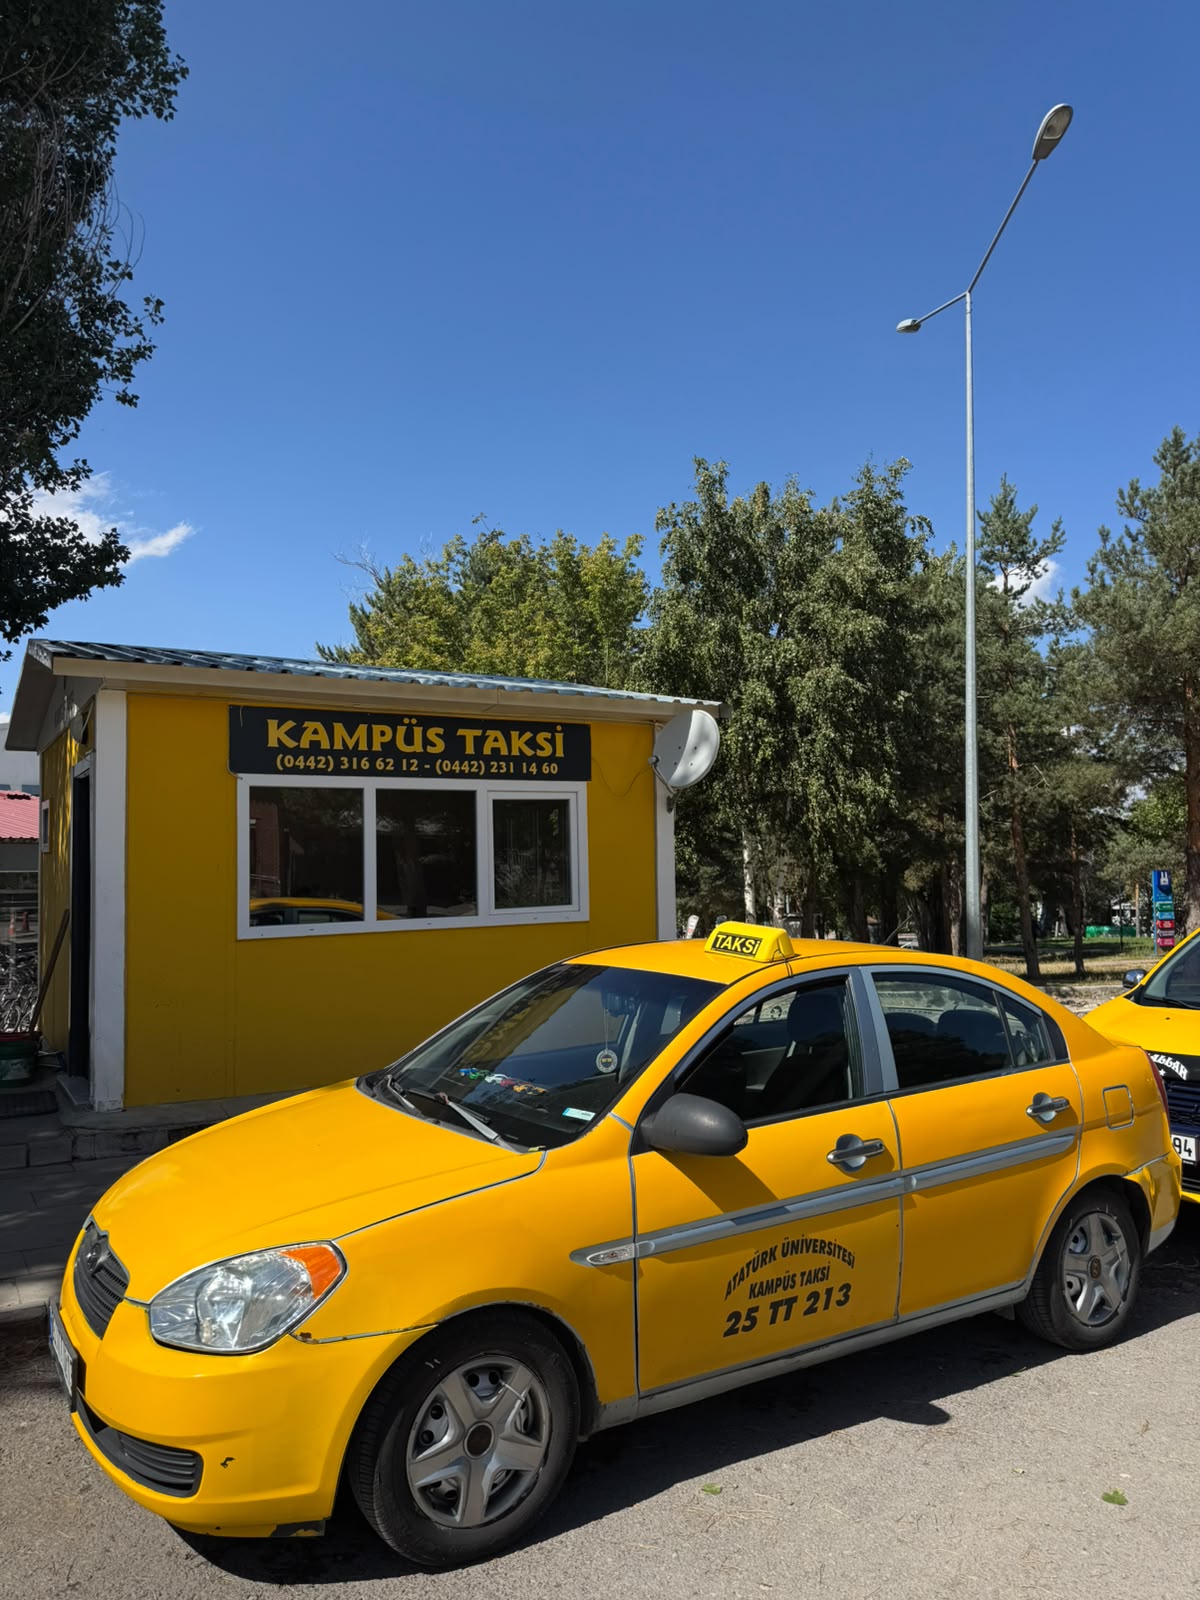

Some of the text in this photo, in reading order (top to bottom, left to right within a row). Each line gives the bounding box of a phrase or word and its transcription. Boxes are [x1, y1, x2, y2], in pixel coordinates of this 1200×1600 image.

[266, 718, 565, 758] KAMPÜS TAKSİ
[276, 754, 334, 771] (0442)
[340, 757, 370, 770] 316
[375, 758, 395, 771] 62
[402, 758, 419, 771] 12
[435, 759, 486, 775] (0442)
[490, 761, 514, 774] 231
[522, 762, 538, 775] 14
[541, 762, 558, 775] 60
[1148, 1052, 1188, 1080] ALLAH
[724, 1245, 778, 1301] ATATÜRK
[748, 1261, 831, 1299] KAMPÜS TAKSİ
[723, 1282, 852, 1338] 25 TT 213
